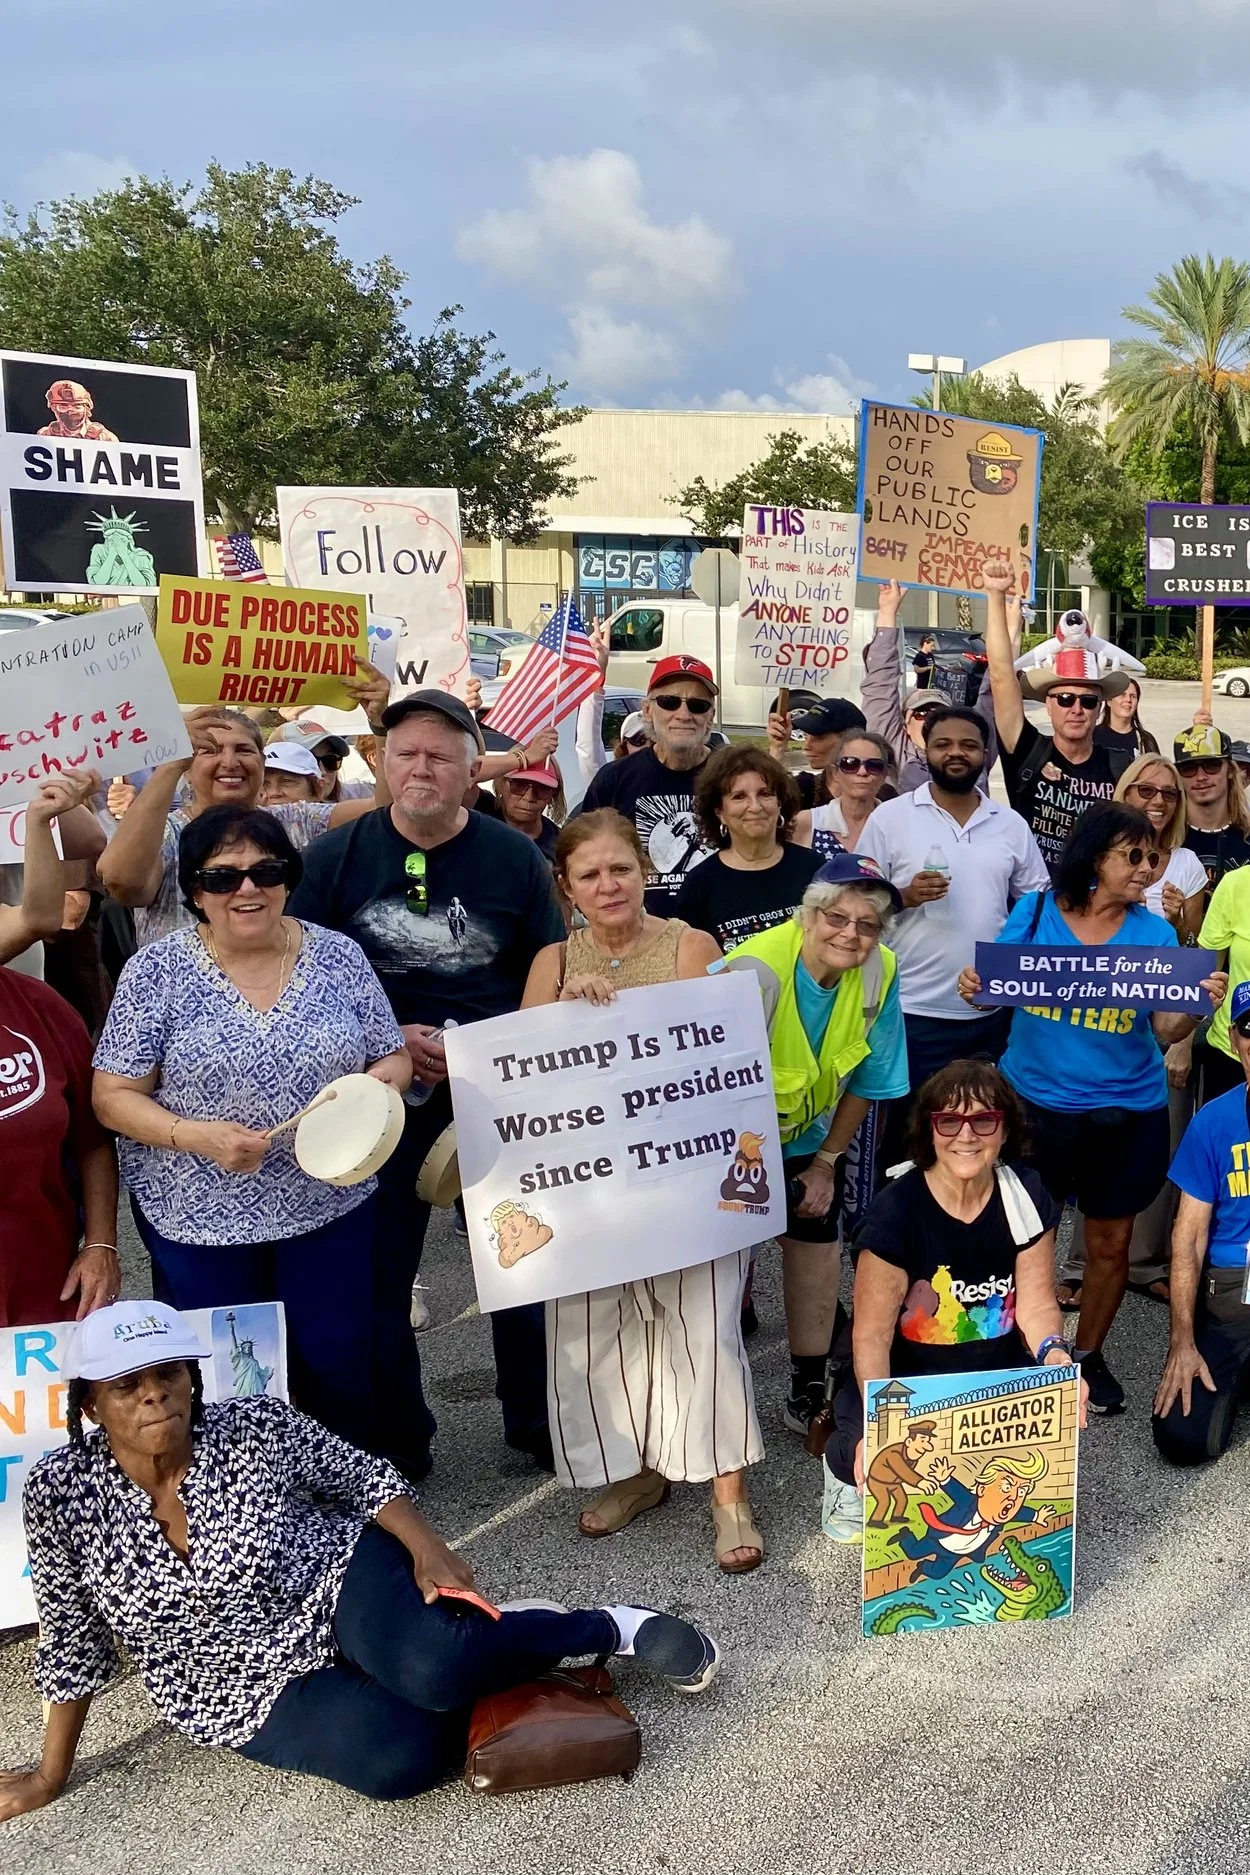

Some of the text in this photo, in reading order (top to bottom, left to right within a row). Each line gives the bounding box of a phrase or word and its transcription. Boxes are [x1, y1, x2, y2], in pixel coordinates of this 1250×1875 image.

[874, 408, 955, 438] HANDS
[888, 435, 932, 454] OFF
[980, 442, 1011, 454] RESIST
[23, 445, 181, 490] SHAME
[886, 455, 934, 479] OUR
[877, 475, 977, 509] PUBLIC
[750, 506, 848, 536] THIS IS THE
[879, 501, 971, 537] LANDS
[1173, 515, 1250, 531] ICE IS
[316, 524, 449, 577] Follow
[745, 534, 857, 565] PART of History
[865, 536, 908, 562] 8647
[924, 532, 1011, 561] IMPEACH
[1181, 543, 1236, 557] BEST
[746, 555, 850, 578] That makes Kids ASK
[748, 575, 842, 605] Why Didn't
[171, 589, 231, 628] DUE
[240, 594, 360, 639] PROCESS
[741, 599, 849, 625] ANYONE DO
[108, 622, 145, 646] CAMP
[755, 622, 849, 646] ANYTHING
[182, 631, 214, 665] IS
[222, 635, 243, 667] A
[252, 638, 357, 677] HUMAN
[749, 642, 849, 669] TO STOP
[218, 674, 307, 704] RIGHT
[761, 665, 829, 687] THEM?
[717, 925, 725, 933] I
[725, 916, 758, 930] DIDN'T
[759, 910, 784, 922] GROW
[1019, 955, 1173, 976] BATTLE for the
[989, 979, 1200, 1002] SOUL of the NATION
[493, 1020, 726, 1082] Trump Is The
[494, 1059, 765, 1145] Worse president
[519, 1127, 737, 1195] since Trump
[112, 1315, 172, 1340] Aruba
[135, 1330, 153, 1339] Happy
[959, 1396, 1055, 1431] ALLIGATOR
[959, 1418, 1053, 1449] ALCATRAZ
